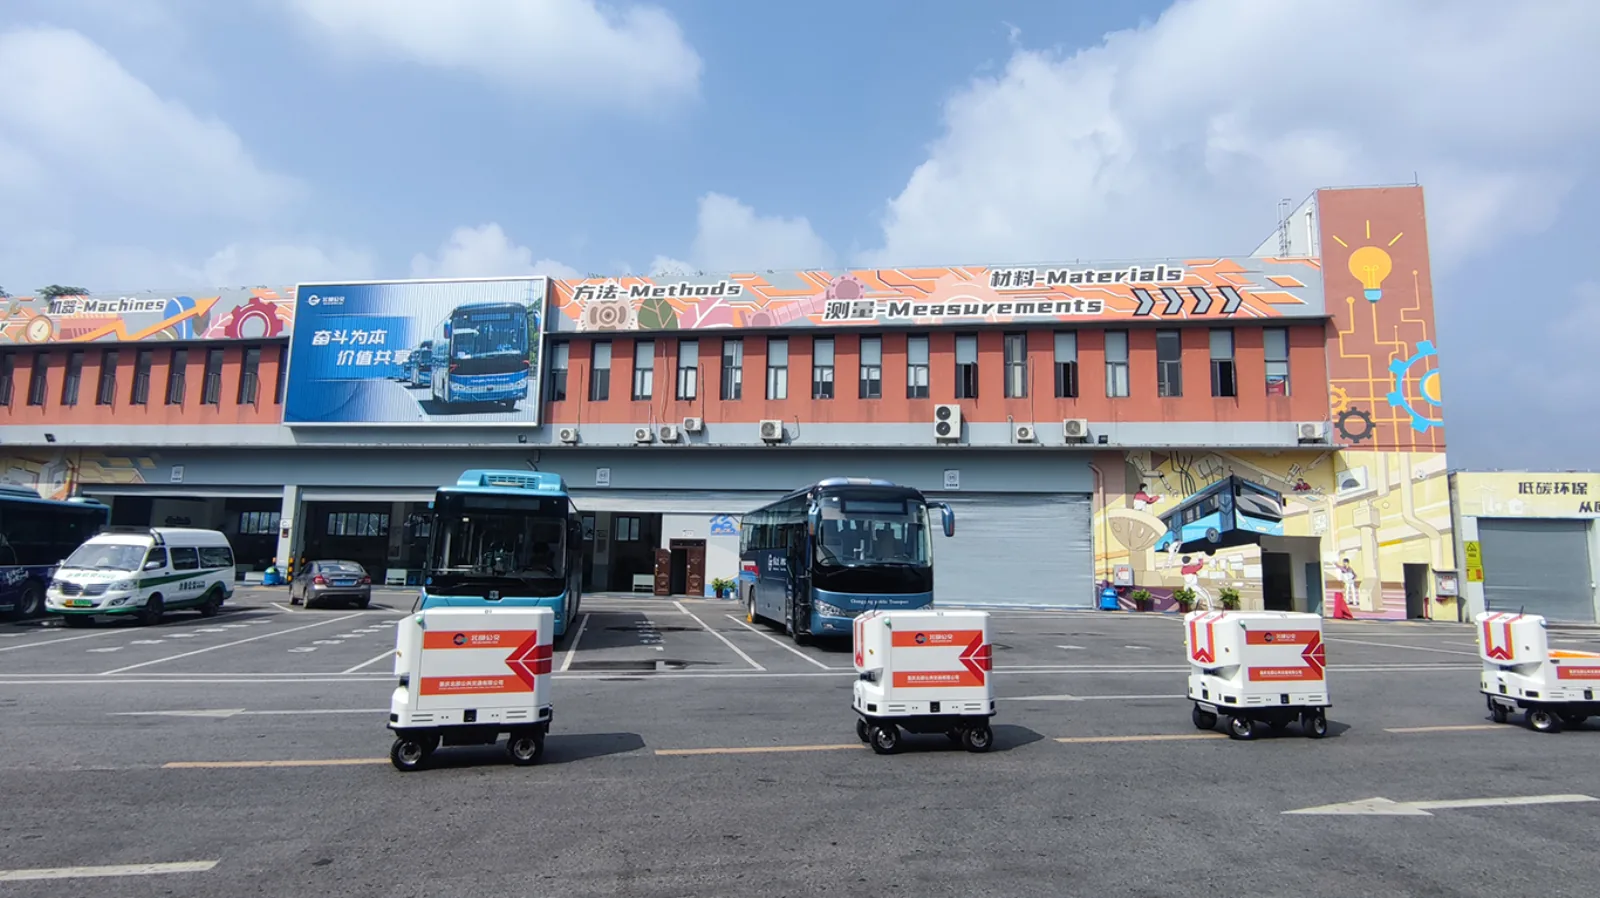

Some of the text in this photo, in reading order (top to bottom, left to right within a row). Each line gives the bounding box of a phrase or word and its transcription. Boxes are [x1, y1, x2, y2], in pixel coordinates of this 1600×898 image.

[991, 265, 1183, 287] 材料-Materials
[573, 281, 742, 300] 方法-Methods
[49, 298, 165, 315] 机器-Machines
[824, 298, 1104, 321] 测量-Measurements
[311, 330, 388, 346] 奋斗为本
[336, 350, 412, 366] 价值共享
[1518, 481, 1588, 495] 低碳环保
